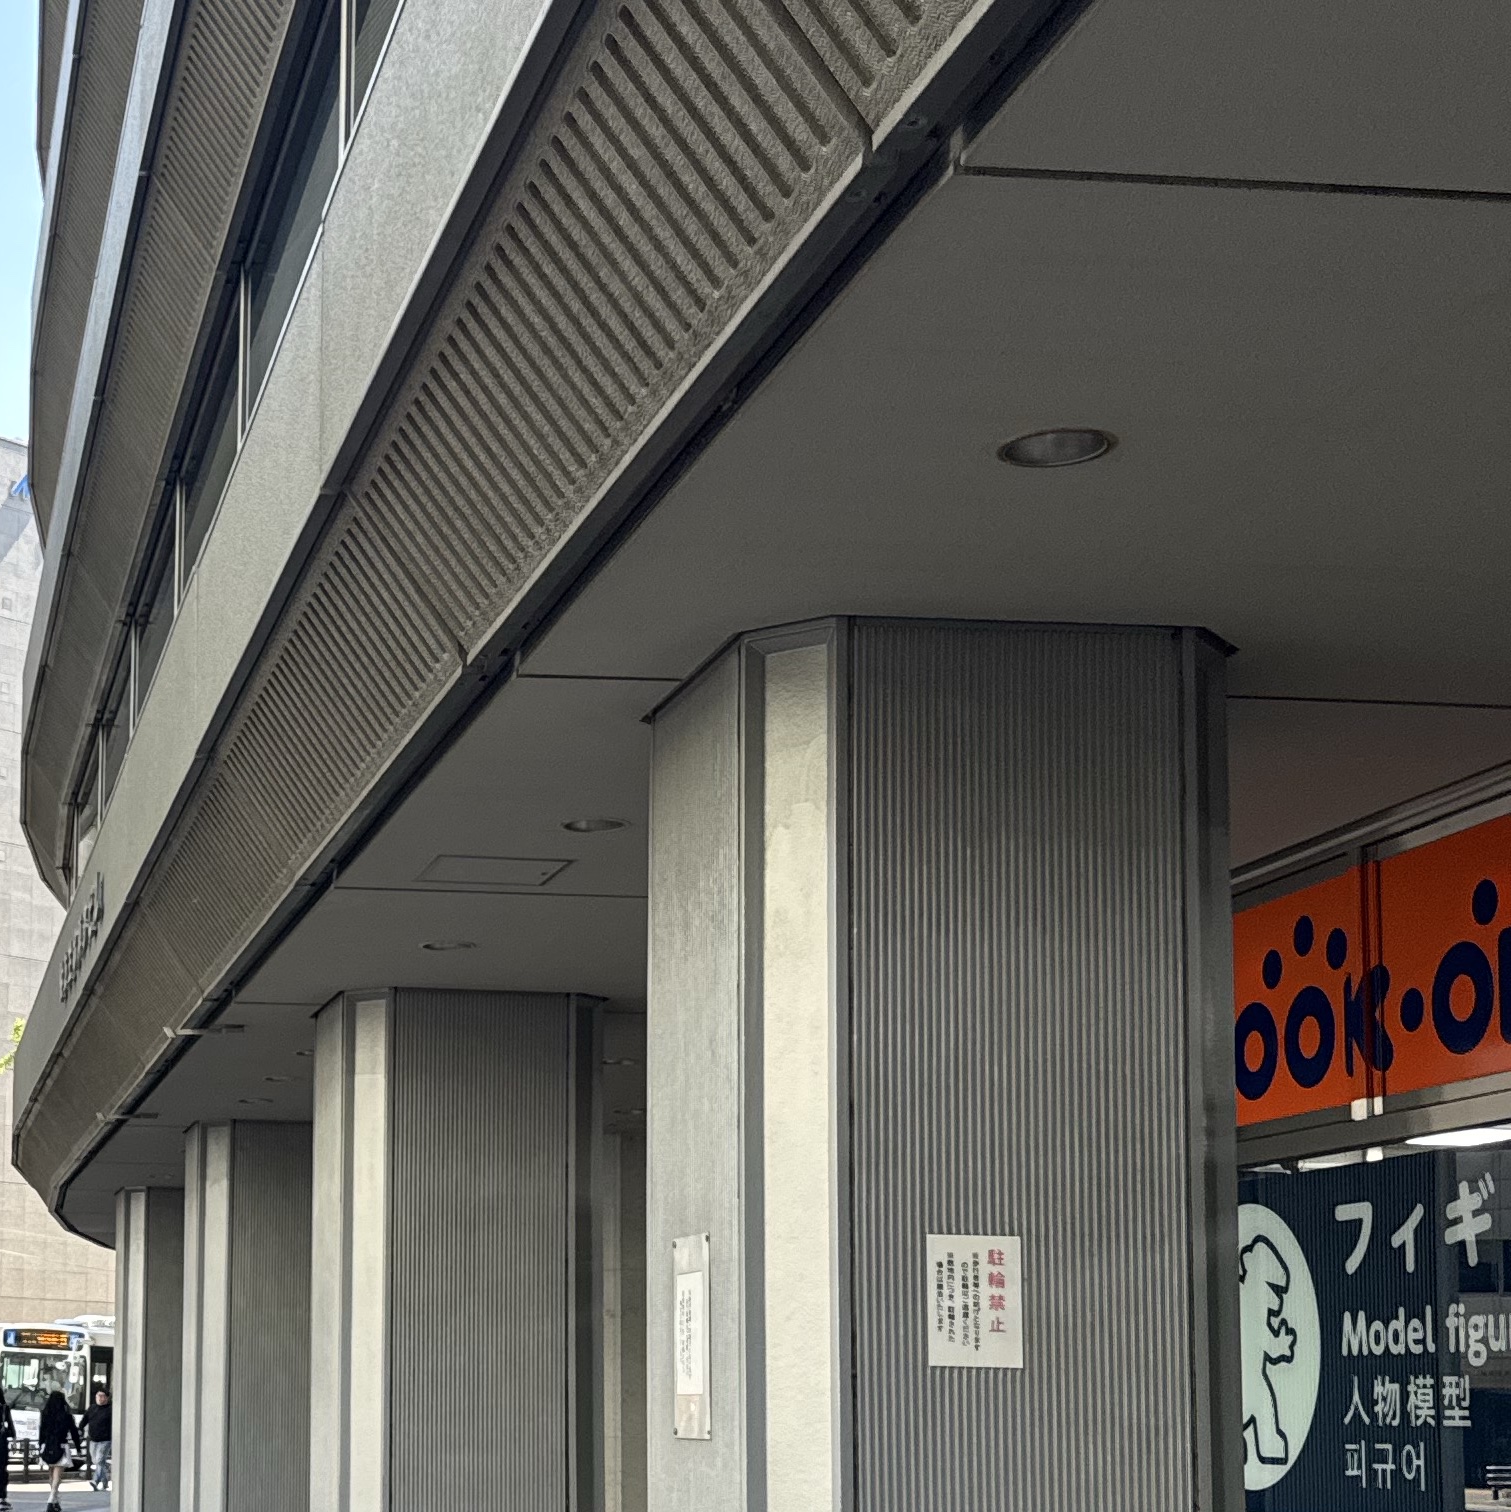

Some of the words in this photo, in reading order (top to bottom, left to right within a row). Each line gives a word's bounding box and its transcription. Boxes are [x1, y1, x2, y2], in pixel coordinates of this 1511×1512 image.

[1335, 1171, 1496, 1276] フィギ
[987, 1248, 1007, 1334] 駐輪禁止
[1341, 1304, 1436, 1357] Model
[1445, 1302, 1511, 1367] figu
[1343, 1374, 1472, 1428] 人物模型
[1343, 1439, 1426, 1492] 피규어
